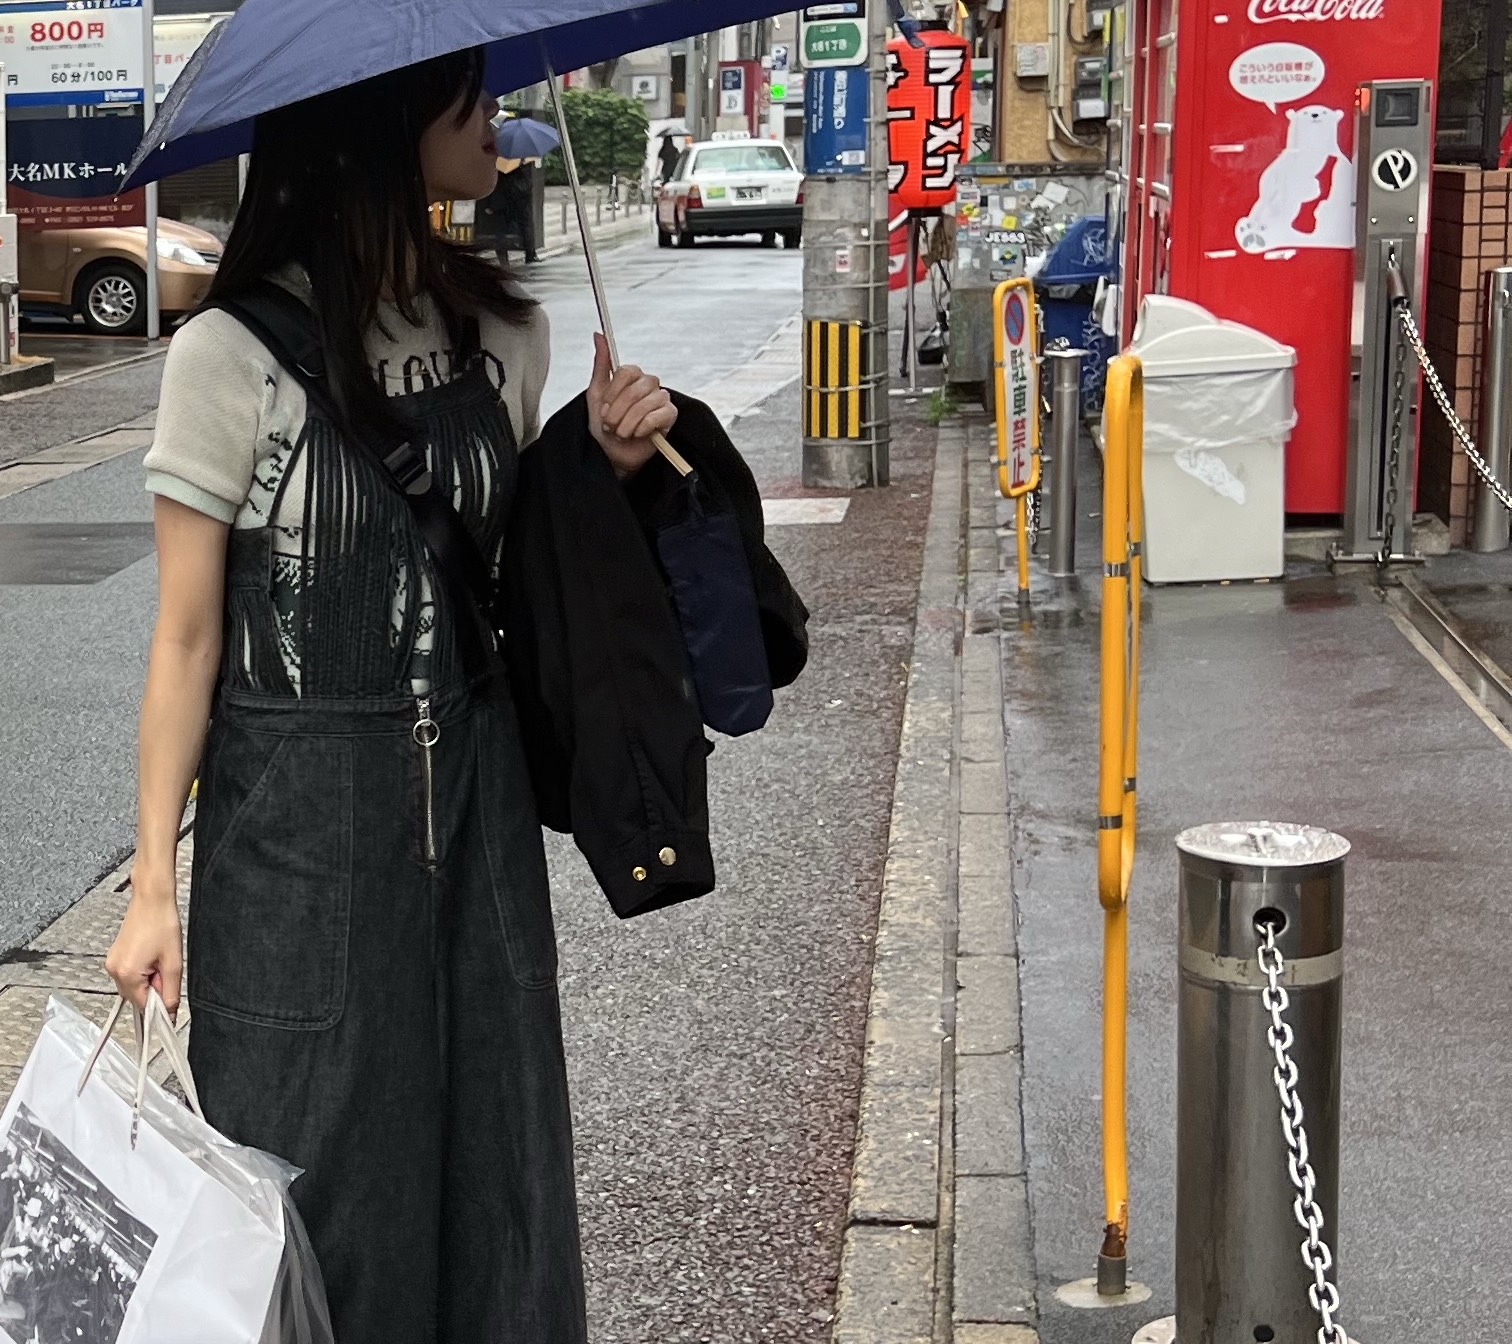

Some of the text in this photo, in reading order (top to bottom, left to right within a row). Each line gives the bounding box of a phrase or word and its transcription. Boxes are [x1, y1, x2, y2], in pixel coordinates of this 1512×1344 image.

[29, 20, 105, 43] 800円
[924, 48, 964, 189] ラーメン
